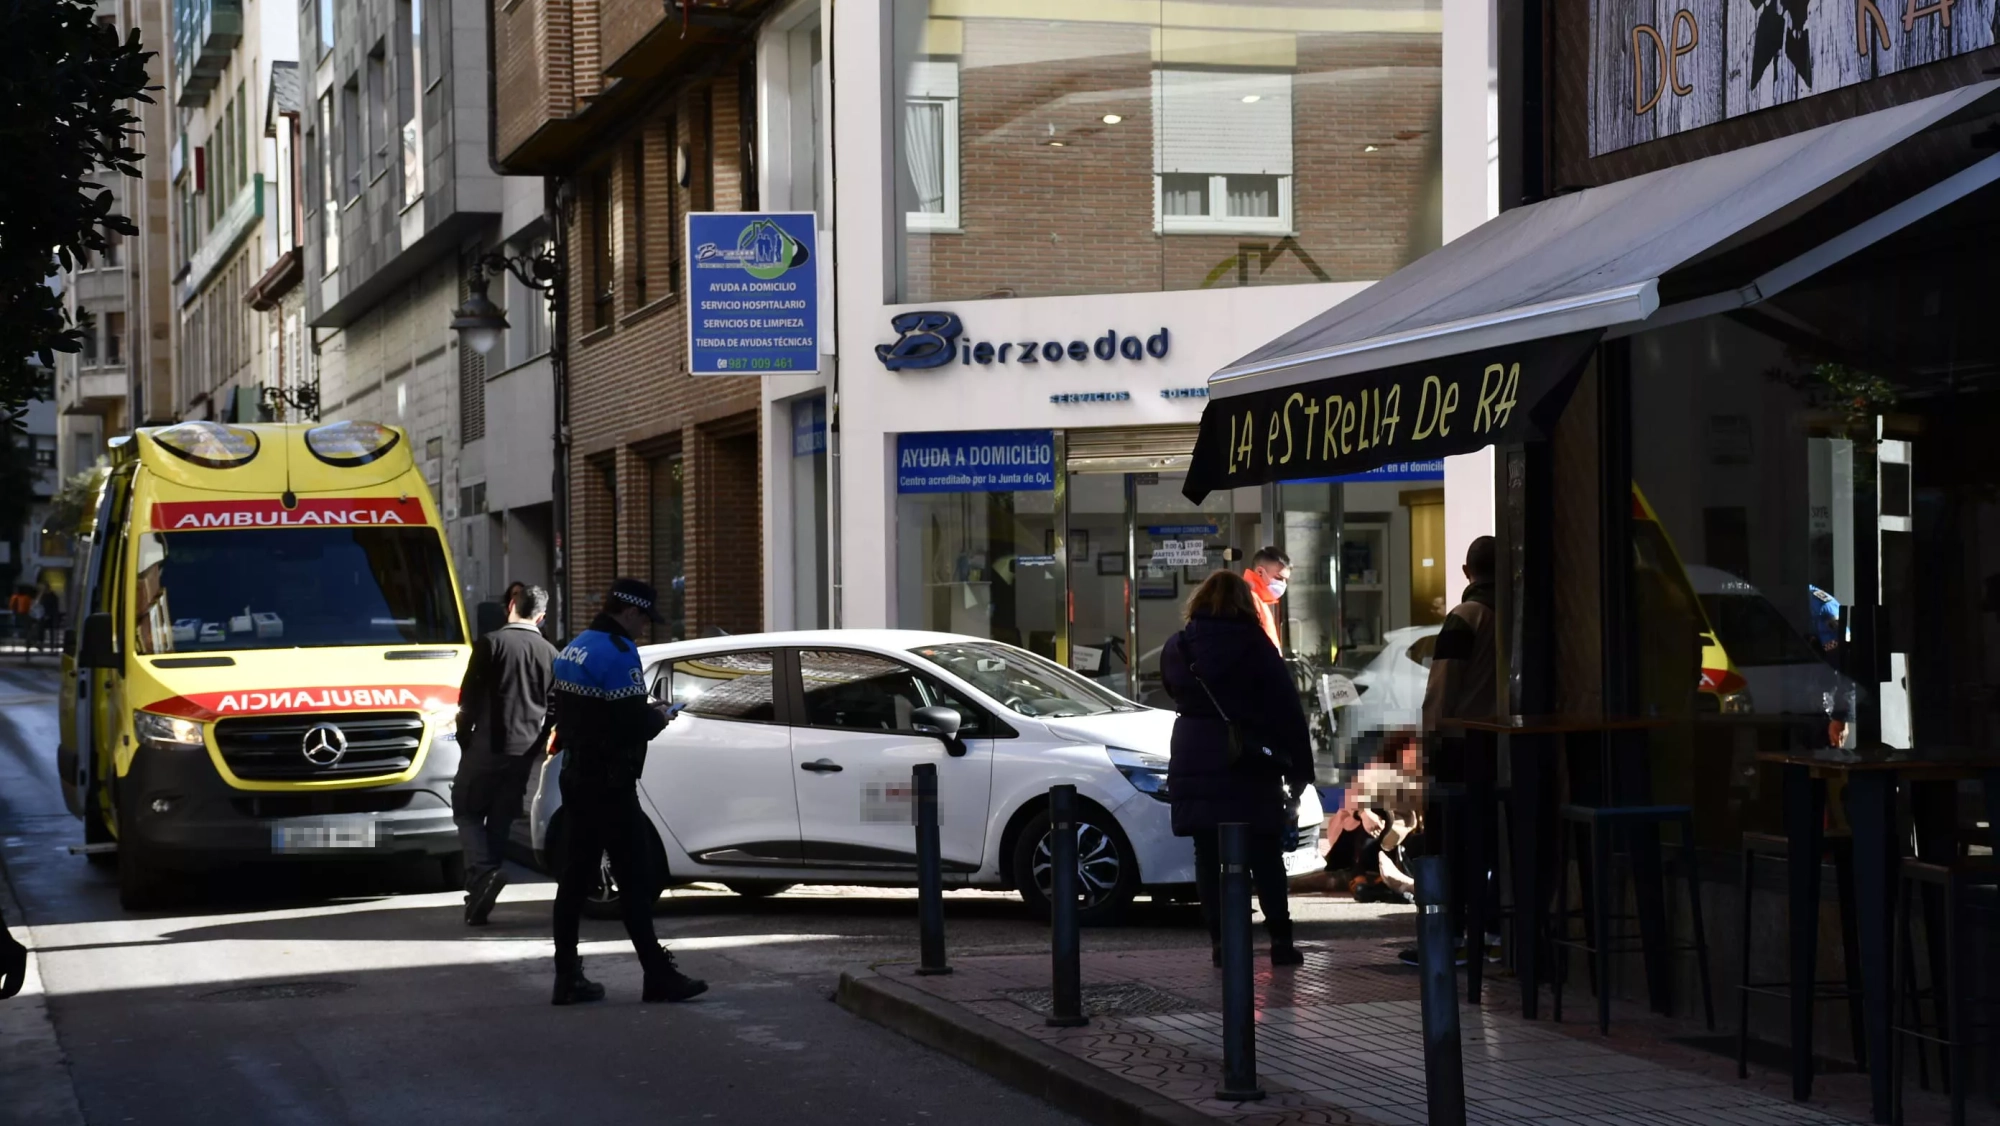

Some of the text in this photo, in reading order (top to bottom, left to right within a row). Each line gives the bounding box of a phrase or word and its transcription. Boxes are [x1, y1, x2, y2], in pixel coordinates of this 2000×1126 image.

[709, 282, 797, 292] AYUDA A DOMICILIO
[701, 300, 806, 310] SERVICIO HOSPITALARIO
[703, 318, 804, 328] SERVICIOS DE LIMPIEZA
[696, 336, 813, 347] TIENDA DE AYUDAS TÉCNICAS
[874, 310, 1170, 372] Bierzoedad
[729, 357, 793, 369] 987 009 461
[1049, 391, 1131, 403] SERVICIOS
[1228, 410, 1253, 475] LA
[1473, 362, 1520, 434] RA
[901, 444, 1051, 468] AYUDA A DOMICILIO
[1387, 463, 1398, 473] en
[1400, 462, 1408, 472] el
[900, 476, 926, 486] Centro
[928, 474, 971, 485] acreditado
[972, 475, 986, 486] por
[988, 473, 996, 484] la
[998, 473, 1021, 484] Junta
[1023, 473, 1034, 483] de
[174, 509, 404, 528] AMBULANCIA
